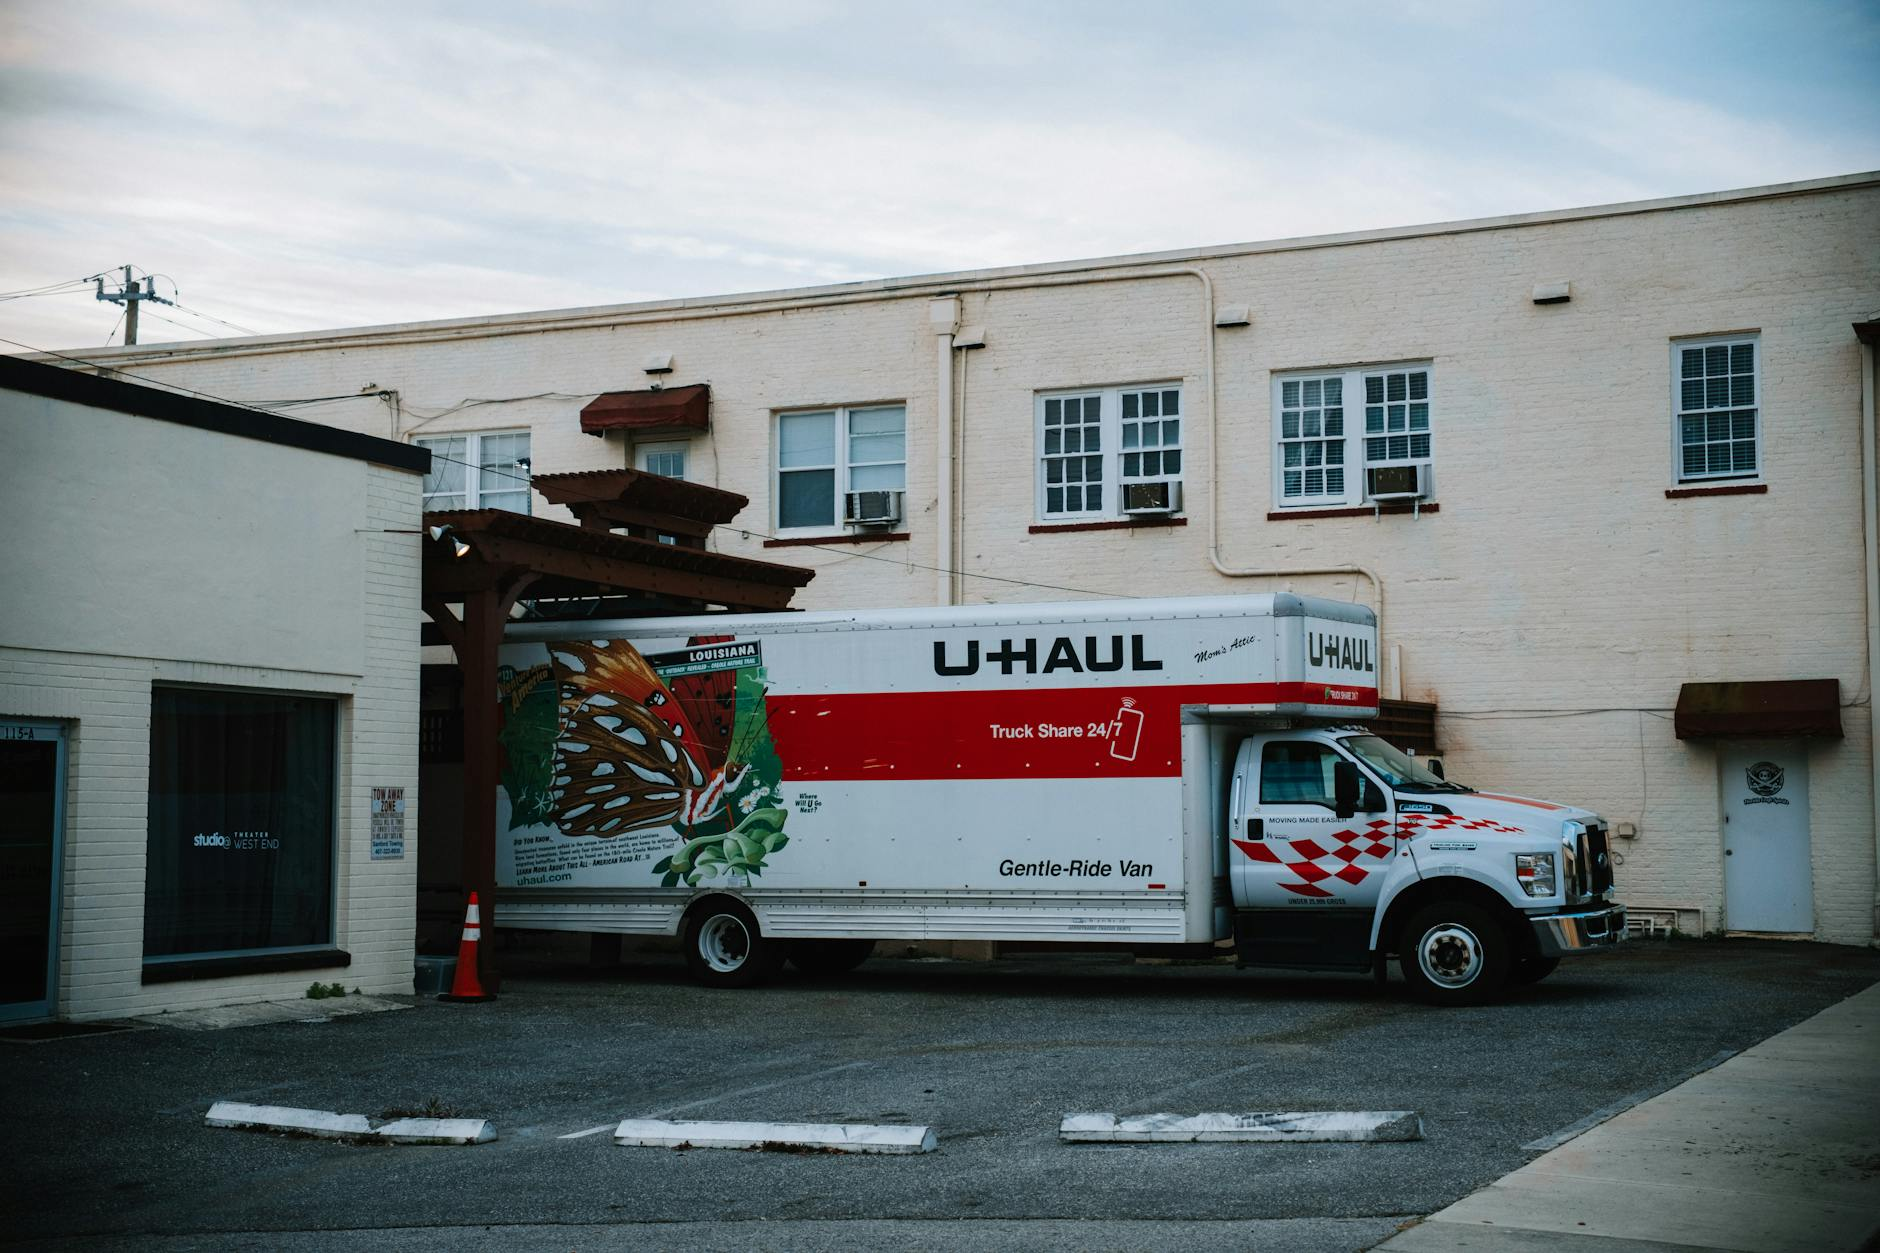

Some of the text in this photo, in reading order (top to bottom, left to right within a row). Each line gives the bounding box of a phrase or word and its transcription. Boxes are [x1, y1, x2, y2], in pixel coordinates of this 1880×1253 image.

[689, 645, 756, 662] LOUISIANA
[933, 634, 1163, 676] U-HAUL
[1194, 636, 1256, 663] Mom's Attic
[1309, 632, 1373, 672] U-HAUL
[5, 727, 34, 739] 115-A
[990, 719, 1123, 739] Truck Share 24/7
[373, 788, 404, 800] TOW AWAY
[381, 800, 396, 812] ZONE
[234, 839, 280, 849] WEST END
[999, 859, 1153, 877] Gentle-Ride Van
[517, 873, 572, 886] uhaul.com
